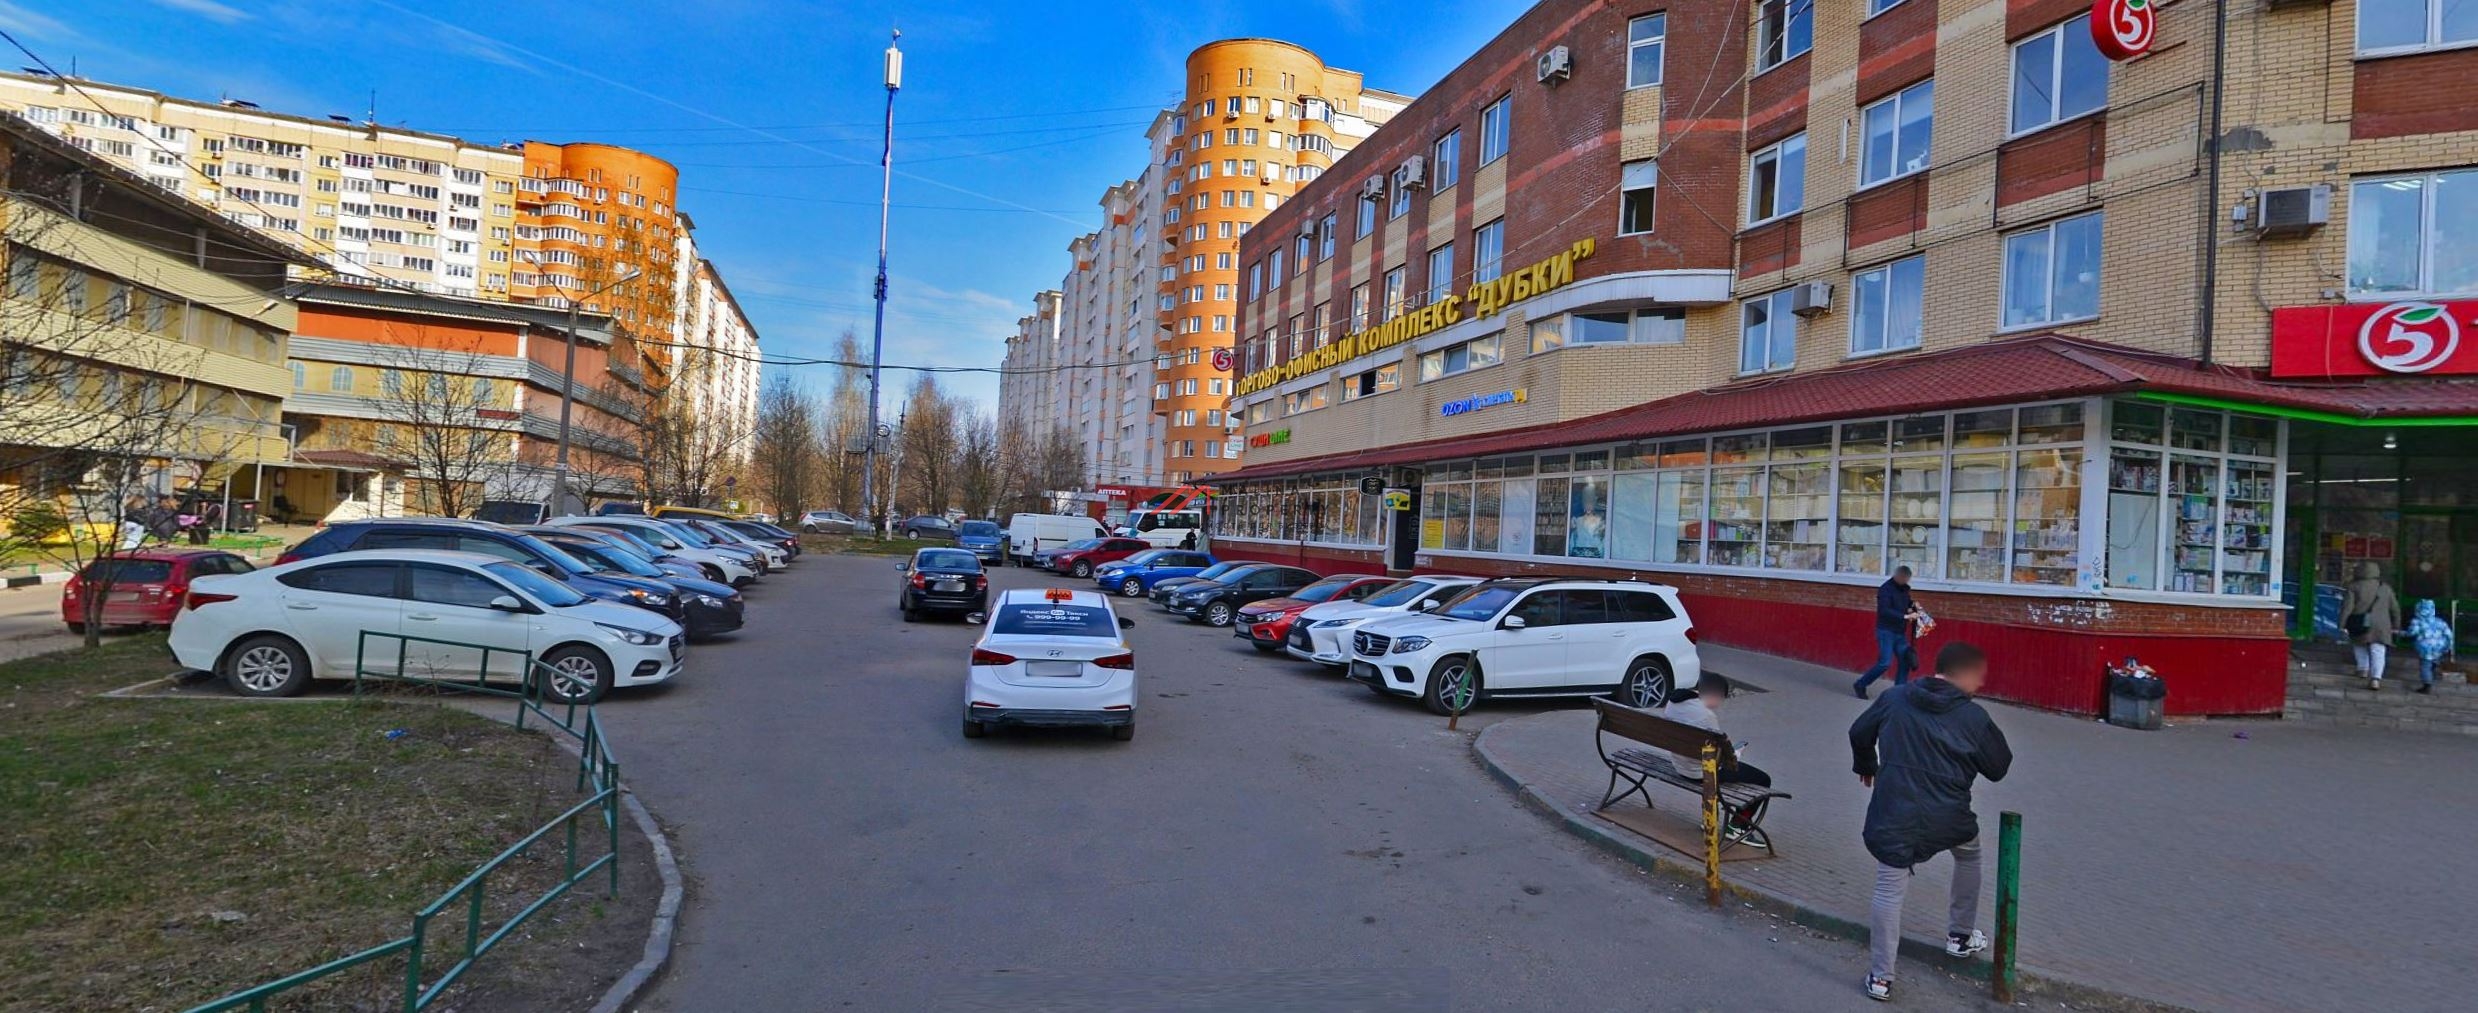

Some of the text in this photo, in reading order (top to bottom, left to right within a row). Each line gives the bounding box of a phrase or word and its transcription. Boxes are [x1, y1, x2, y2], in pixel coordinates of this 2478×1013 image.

[2117, 10, 2143, 43] 5
[1236, 331, 1355, 397] ТОРГОВО-ОФИСНЫЙ
[1357, 294, 1463, 357] КОМПЛЕКС
[2378, 323, 2434, 366] 5
[1441, 400, 1471, 416] OZON
[1097, 488, 1126, 496] АПТЕКА
